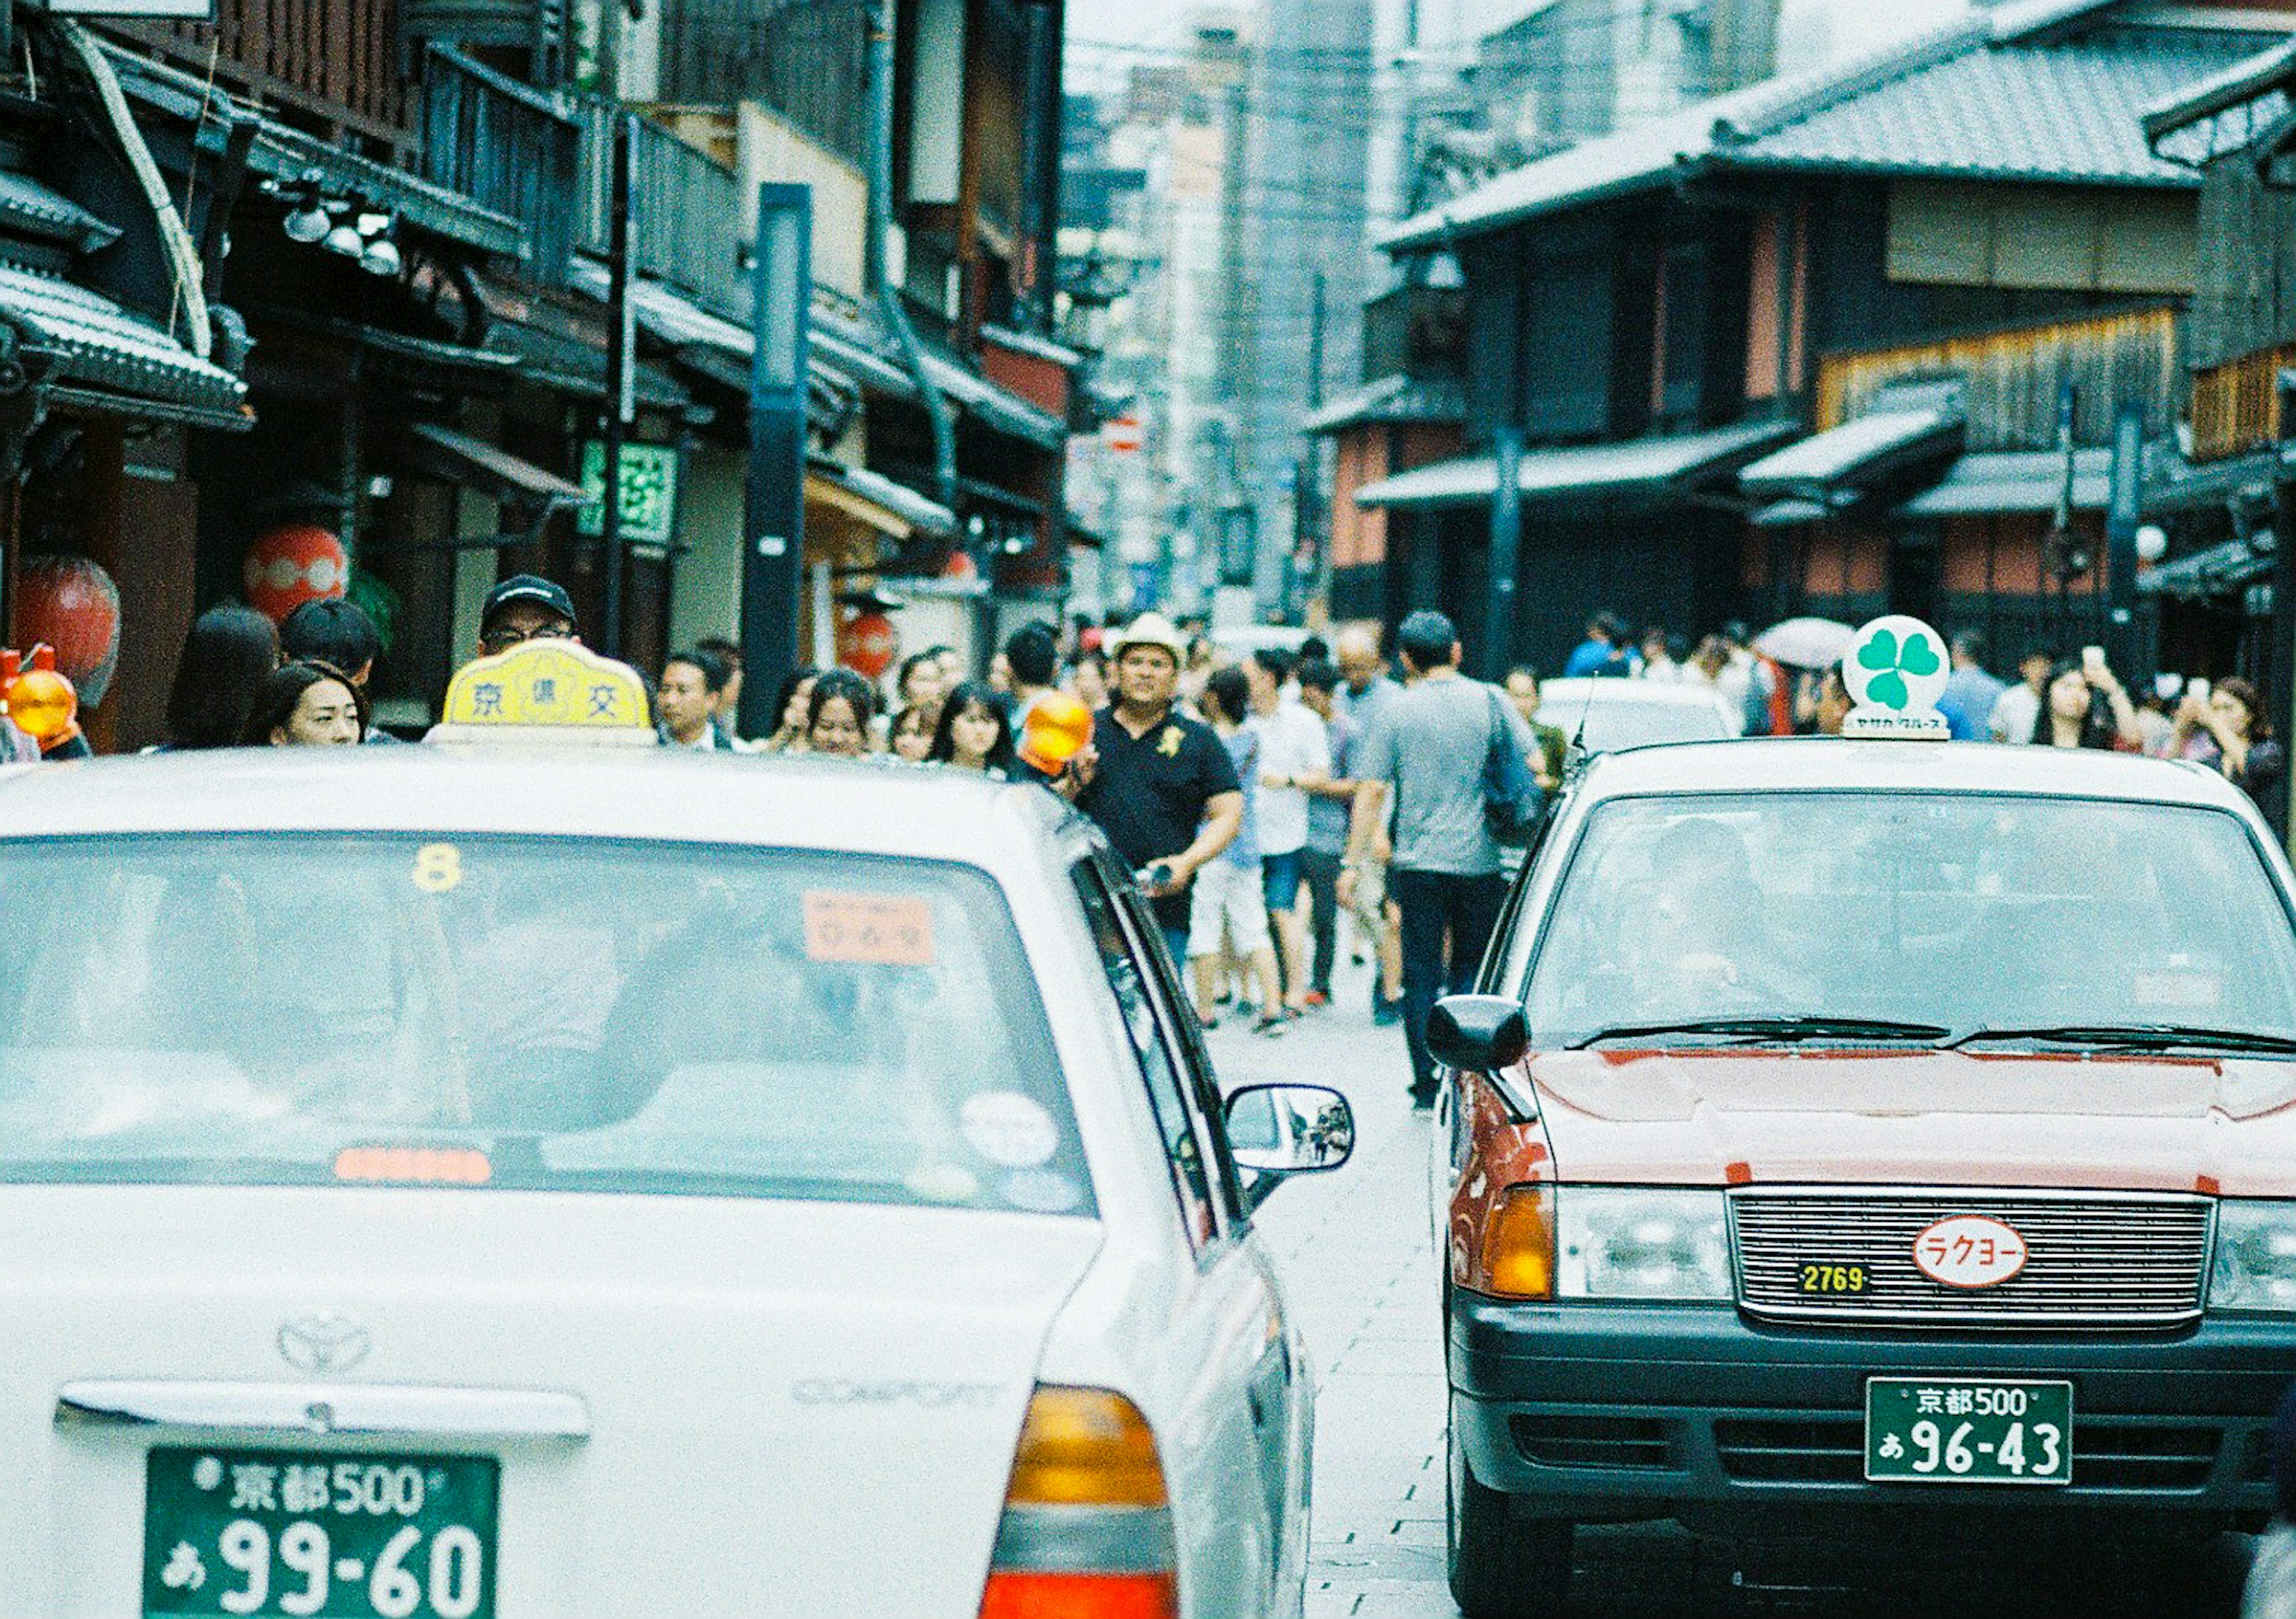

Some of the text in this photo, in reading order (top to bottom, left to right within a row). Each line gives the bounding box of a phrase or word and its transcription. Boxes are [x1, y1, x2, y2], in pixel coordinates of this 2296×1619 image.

[414, 842, 461, 892] 8
[1926, 1234, 2016, 1266] ラクヨー
[1803, 1266, 1863, 1292] 2769
[1916, 1386, 2028, 1417] 京都500
[1878, 1419, 2062, 1476] あ 96-43
[230, 1462, 425, 1516] 京都500
[161, 1519, 481, 1618] あ 99-60
